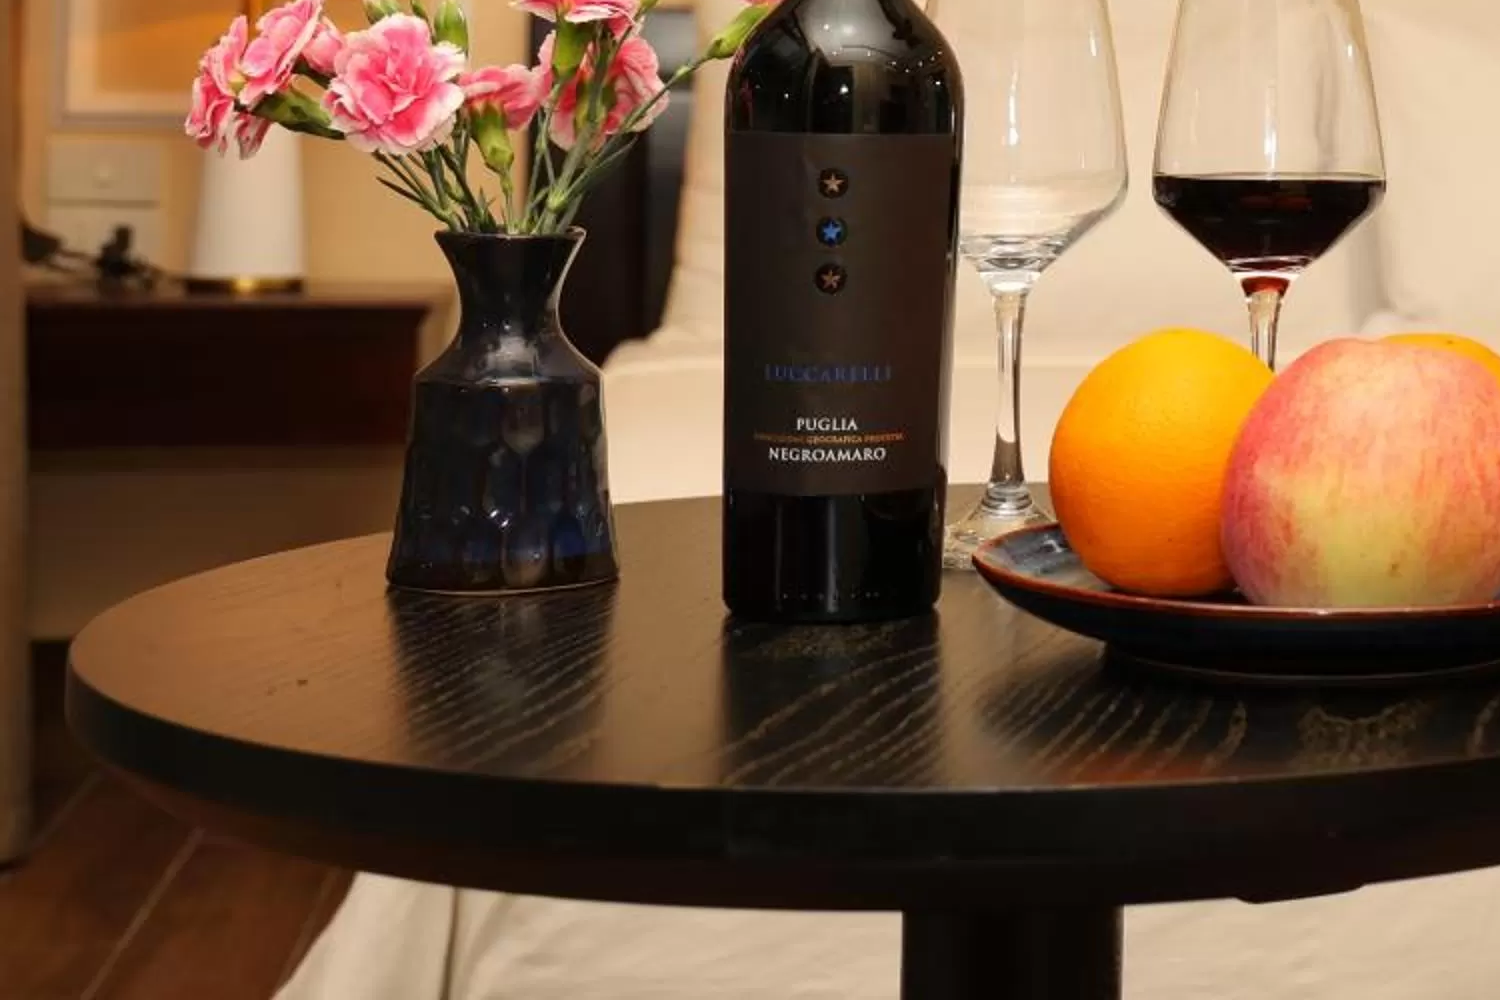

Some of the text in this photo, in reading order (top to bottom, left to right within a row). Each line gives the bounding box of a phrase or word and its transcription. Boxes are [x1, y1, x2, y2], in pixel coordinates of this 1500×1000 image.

[766, 365, 891, 382] LUCCARELLI
[796, 417, 858, 431] PUGLIA
[768, 447, 887, 462] NEGROAMARO
